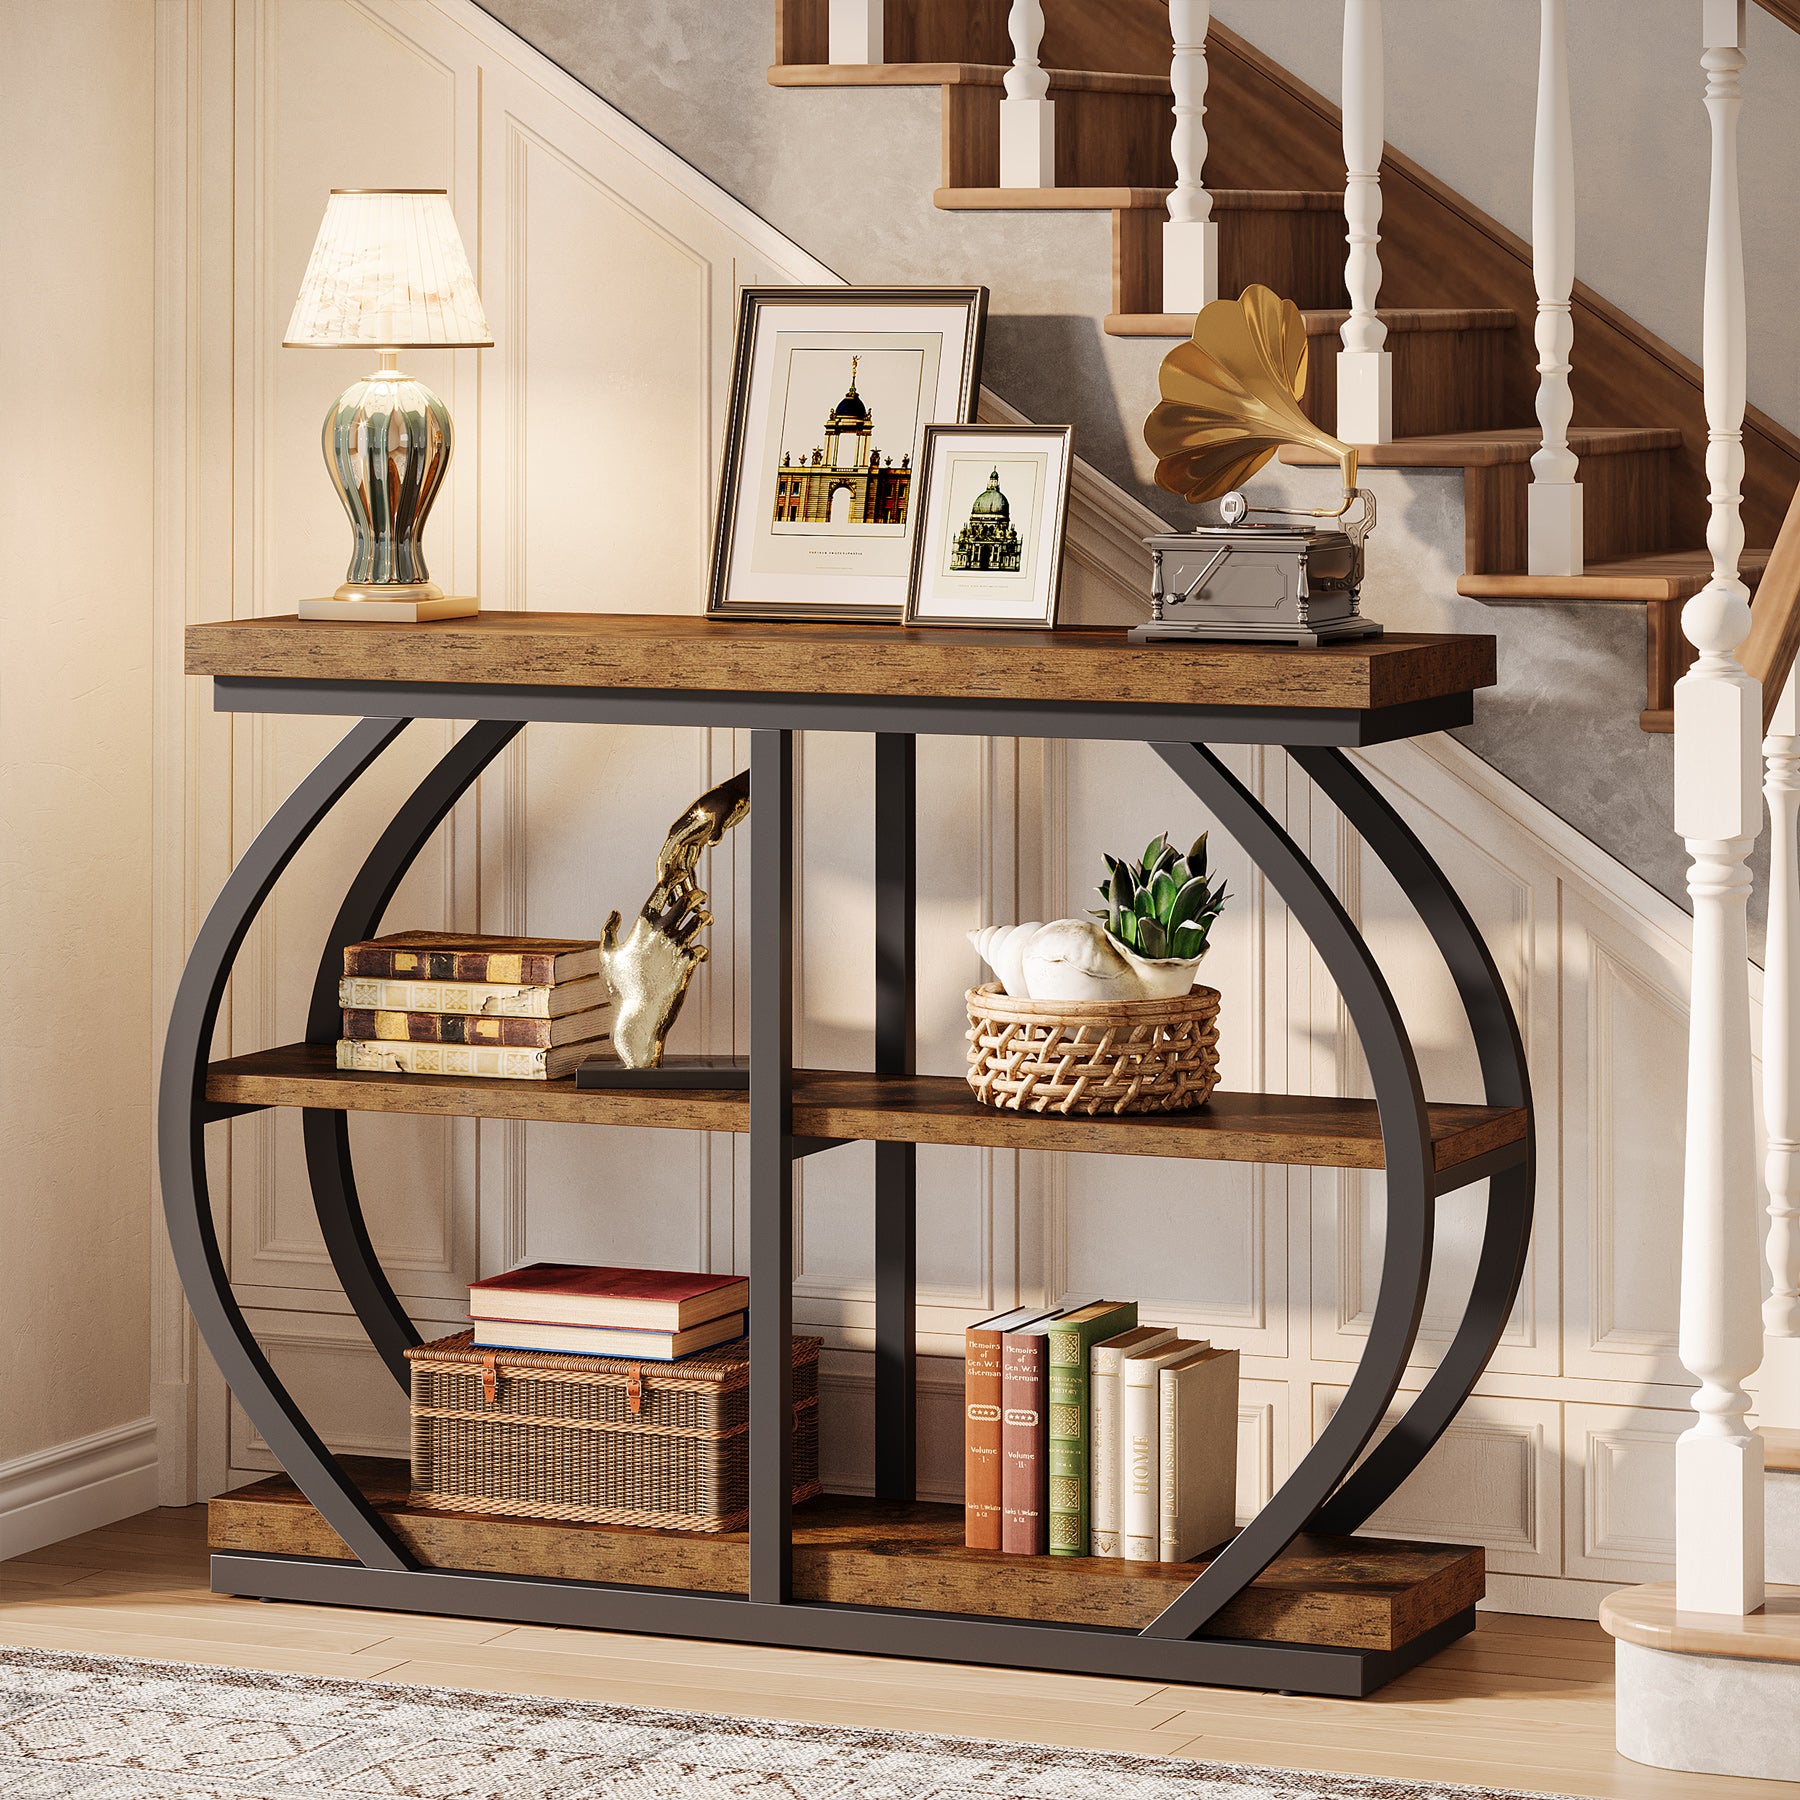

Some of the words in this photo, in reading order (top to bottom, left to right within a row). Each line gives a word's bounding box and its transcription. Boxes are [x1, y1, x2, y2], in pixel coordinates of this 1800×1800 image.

[969, 1341, 1000, 1350] Memoirs
[1006, 1345, 1038, 1355] Memoirs
[980, 1350, 988, 1358] of
[1017, 1355, 1025, 1363] of
[967, 1367, 1001, 1377] Sherman
[1004, 1372, 1039, 1382] Sherman
[1164, 1382, 1175, 1408] WITH
[1164, 1410, 1175, 1429] THE
[971, 1446, 997, 1454] Volume
[1164, 1431, 1175, 1467] THINGS
[1007, 1451, 1035, 1460] Volume
[1133, 1434, 1149, 1495] HOME
[1164, 1468, 1175, 1485] WE
[1164, 1486, 1175, 1511] LOVE
